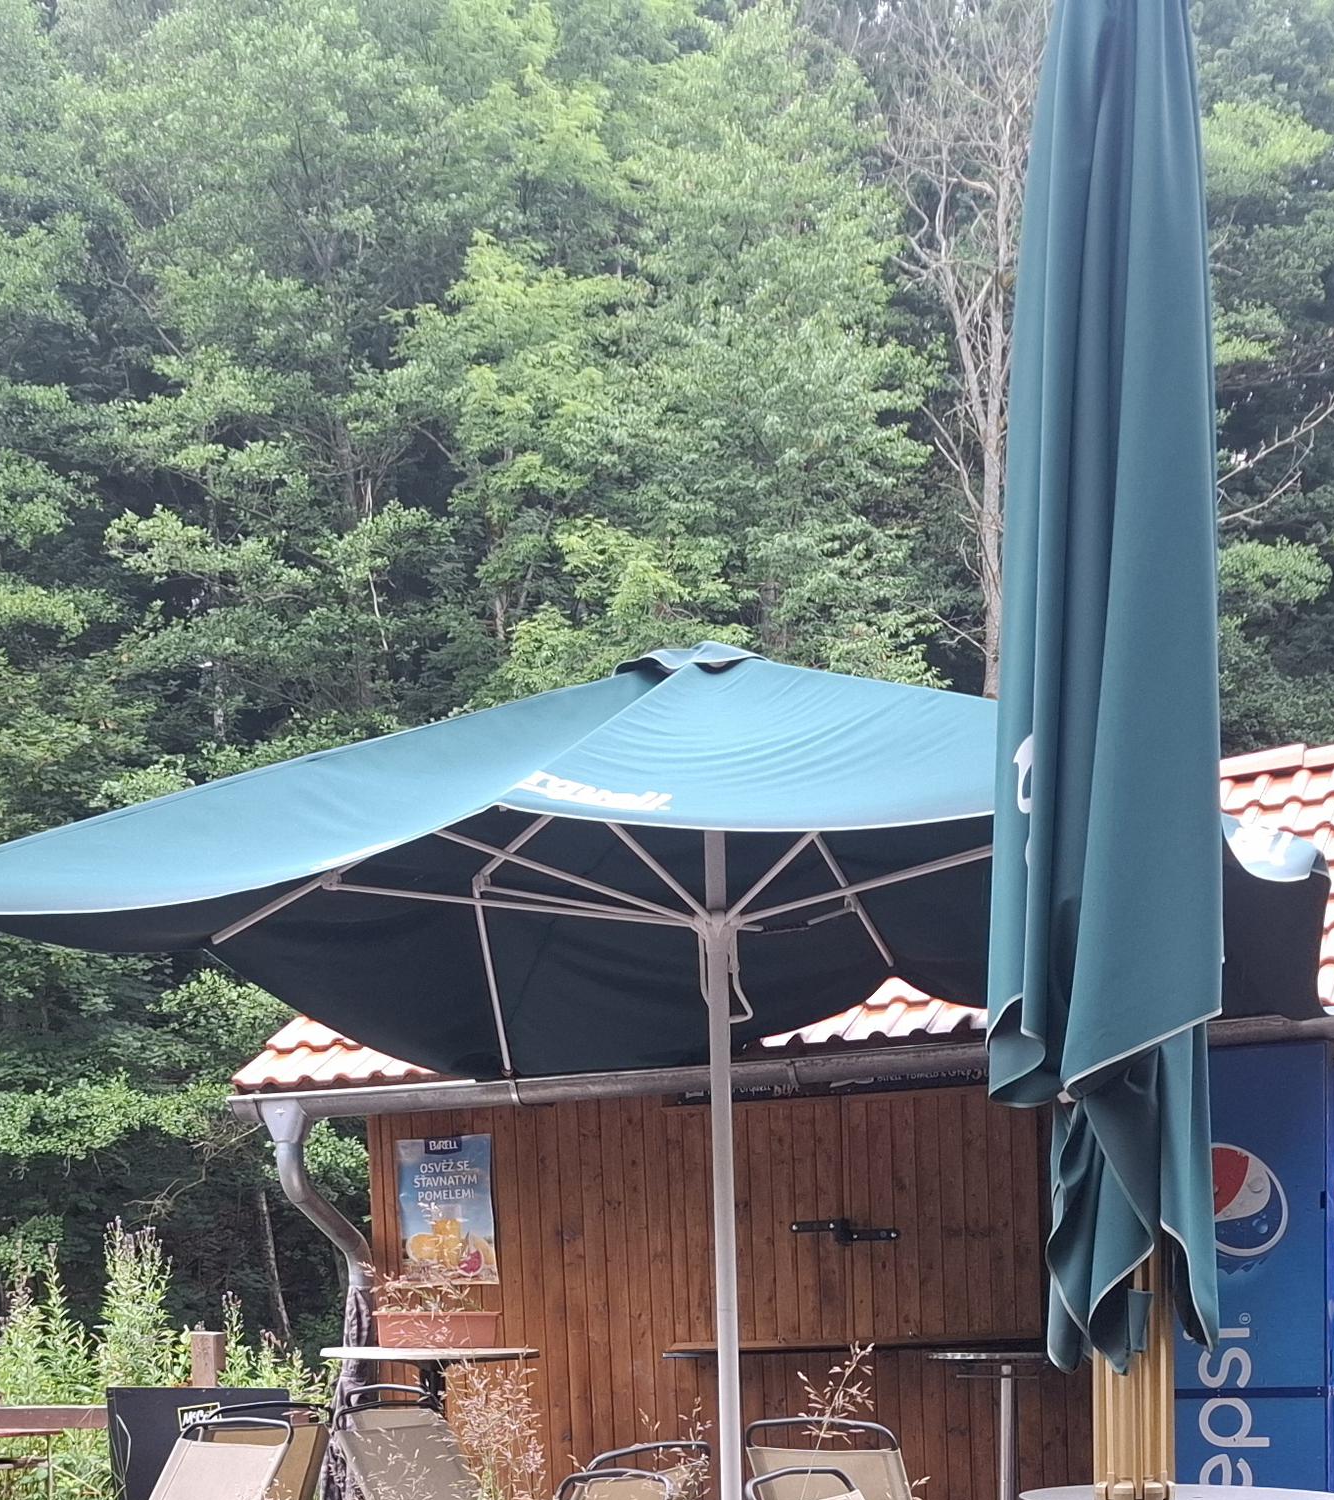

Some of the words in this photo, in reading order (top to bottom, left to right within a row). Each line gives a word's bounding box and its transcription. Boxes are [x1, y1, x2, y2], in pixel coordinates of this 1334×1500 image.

[420, 1159, 454, 1174] OSVĚŽ
[457, 1160, 470, 1171] SE
[413, 1173, 478, 1188] ŠŤAVNATÝM
